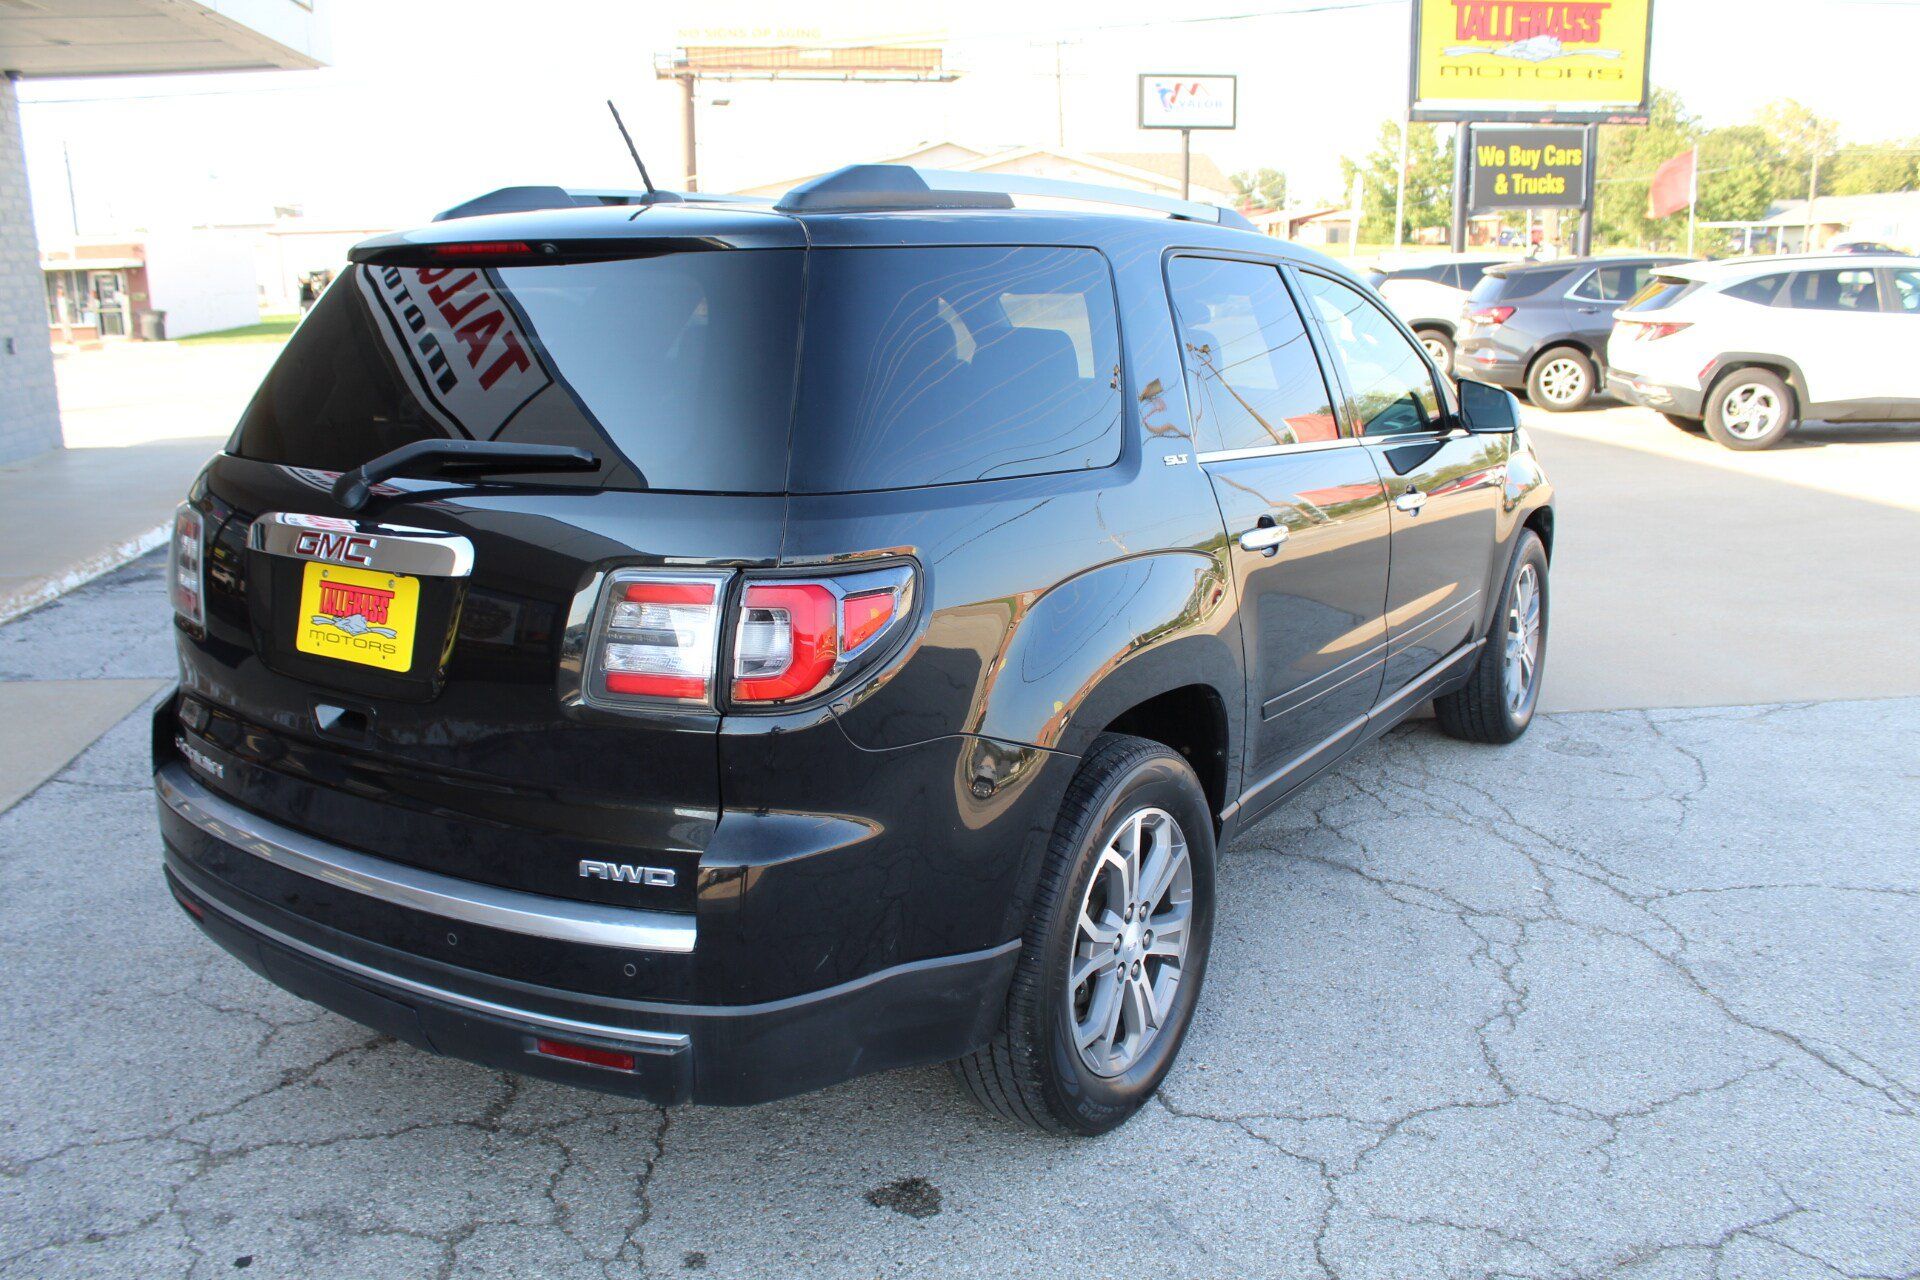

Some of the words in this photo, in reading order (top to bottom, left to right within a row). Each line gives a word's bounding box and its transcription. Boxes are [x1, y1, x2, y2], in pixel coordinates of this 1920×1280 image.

[678, 28, 700, 38] NO
[704, 28, 747, 38] SIGNS
[776, 28, 822, 38] AGING
[1452, 1, 1612, 43] TALLGRASS
[1478, 145, 1505, 167] We
[1509, 145, 1541, 170] Buy
[1543, 144, 1582, 167] Cars
[1494, 173, 1508, 195] &
[1511, 172, 1565, 195] Trucks
[1163, 453, 1188, 466] SLT
[295, 530, 377, 566] GMC
[319, 580, 395, 625] TALLGRASS
[309, 629, 396, 654] MOTORS
[579, 859, 675, 887] AWD
